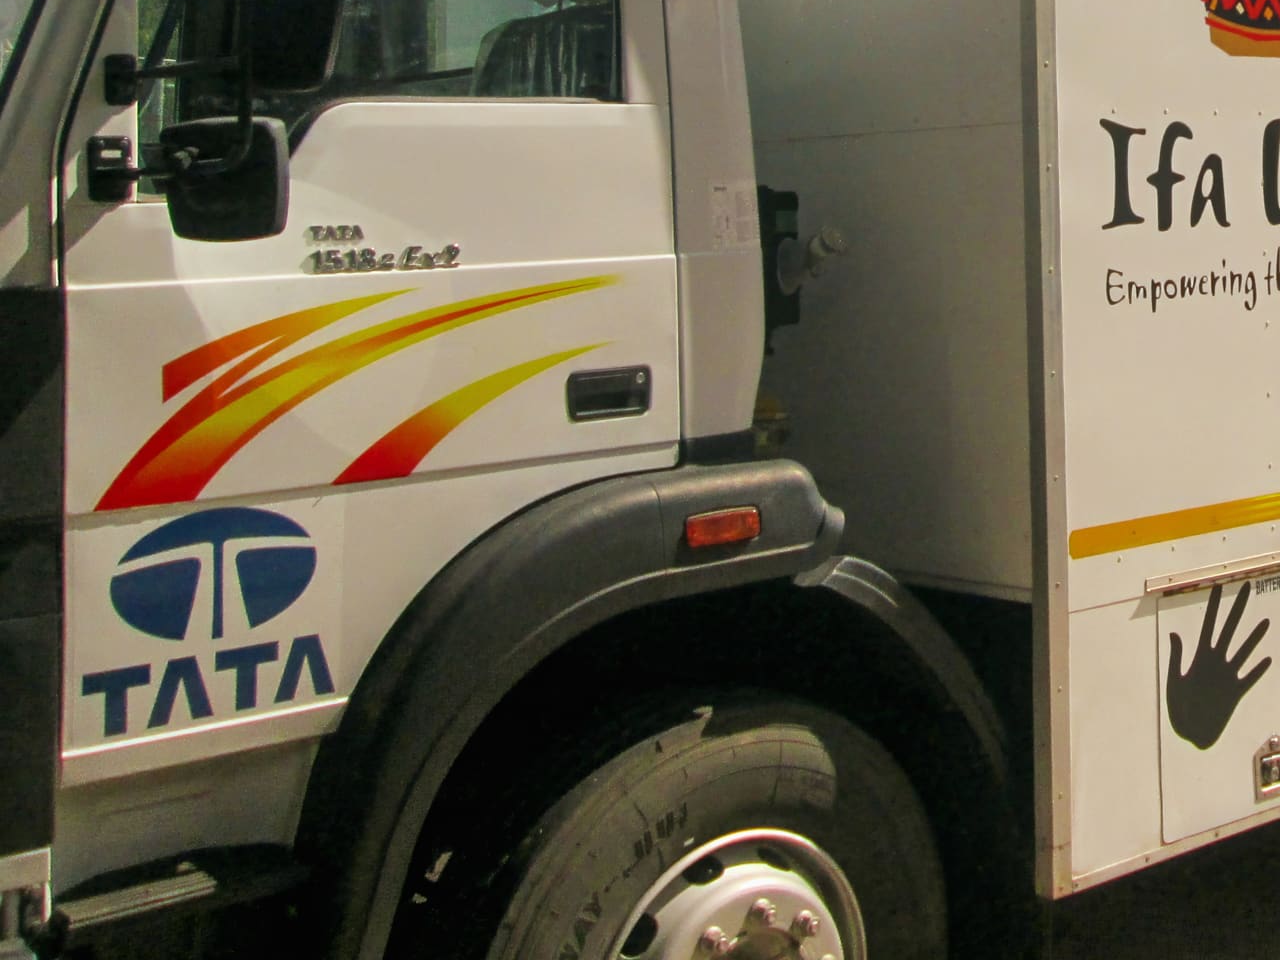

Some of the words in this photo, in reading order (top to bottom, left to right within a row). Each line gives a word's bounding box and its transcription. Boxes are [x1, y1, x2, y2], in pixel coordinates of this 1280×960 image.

[1099, 117, 1231, 232] Ifa
[309, 224, 364, 241] TATA
[1106, 258, 1257, 313] Empowering
[81, 633, 336, 738] TATA
